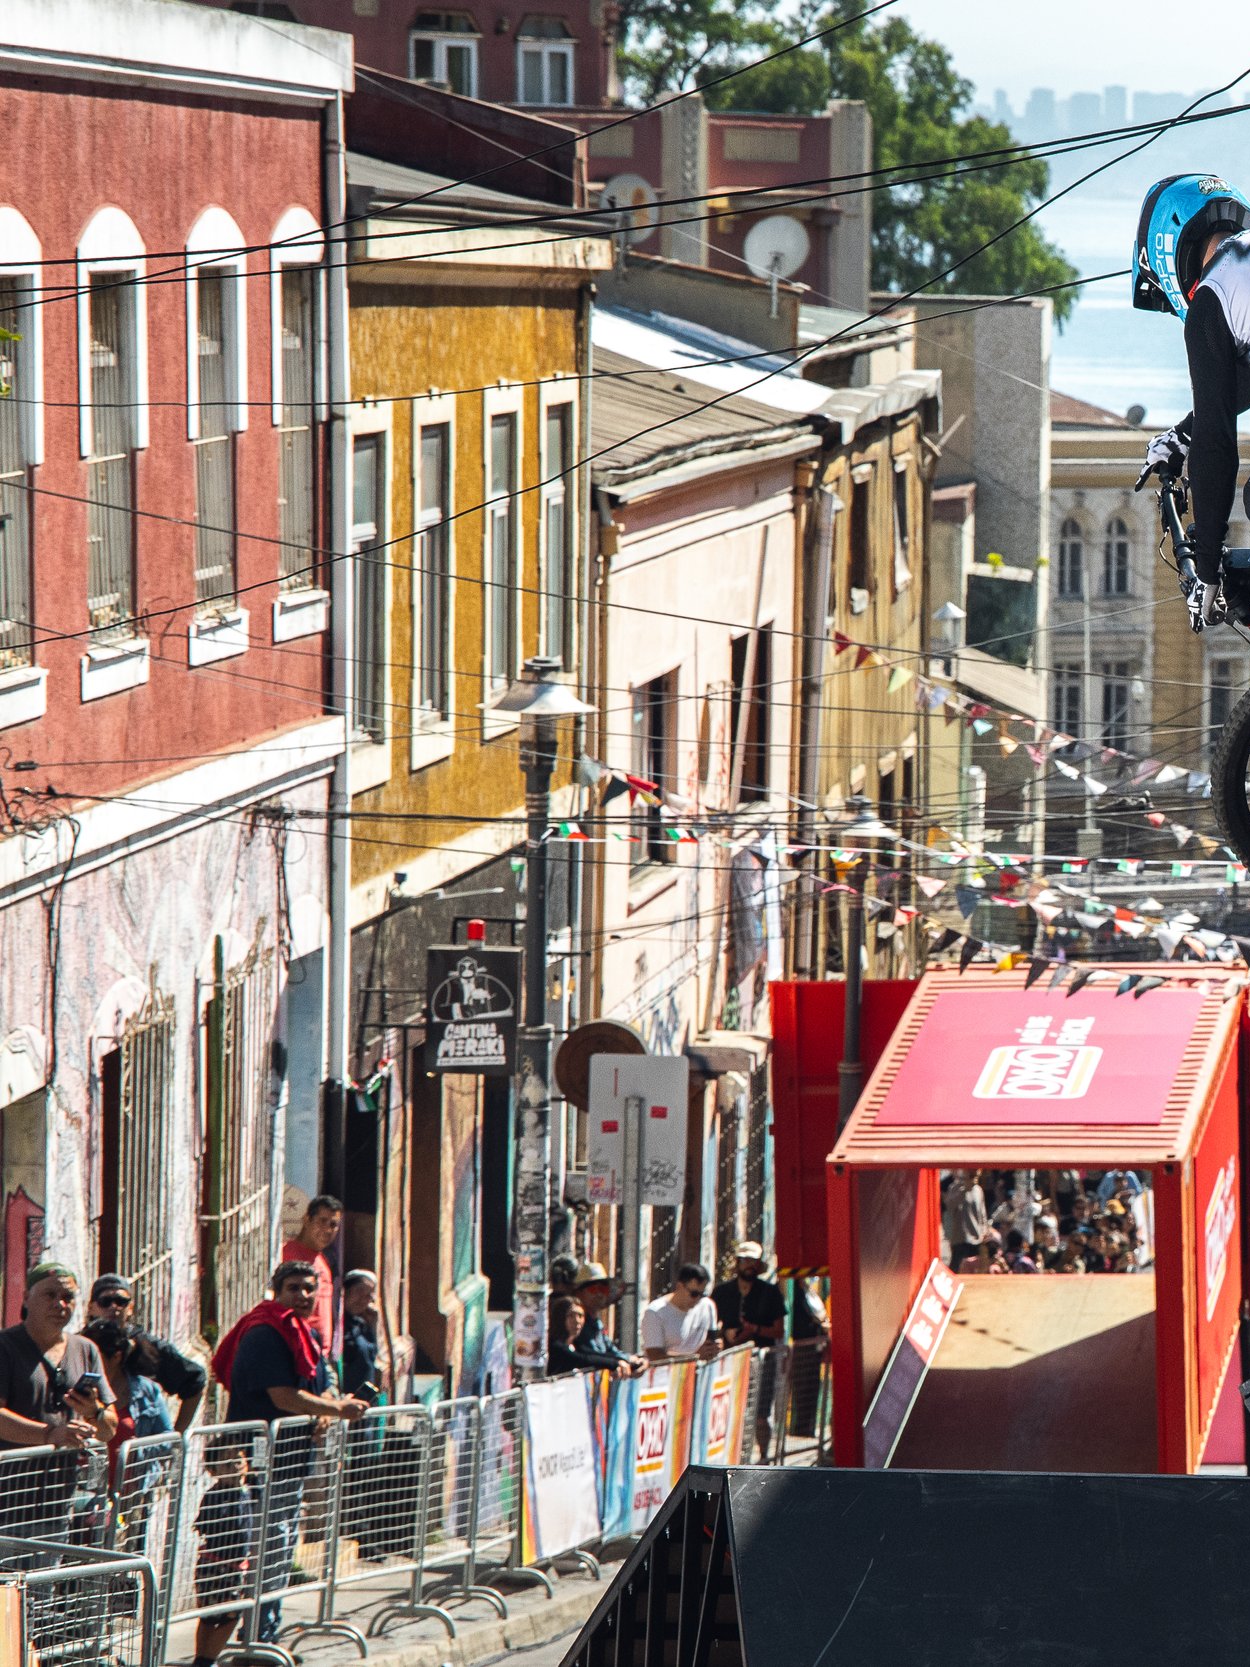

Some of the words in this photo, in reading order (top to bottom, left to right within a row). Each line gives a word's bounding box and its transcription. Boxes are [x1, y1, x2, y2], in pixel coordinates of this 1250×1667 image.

[1155, 232, 1181, 311] GoPro
[998, 1048, 1079, 1095] OXXO
[636, 1404, 667, 1460] OXXO
